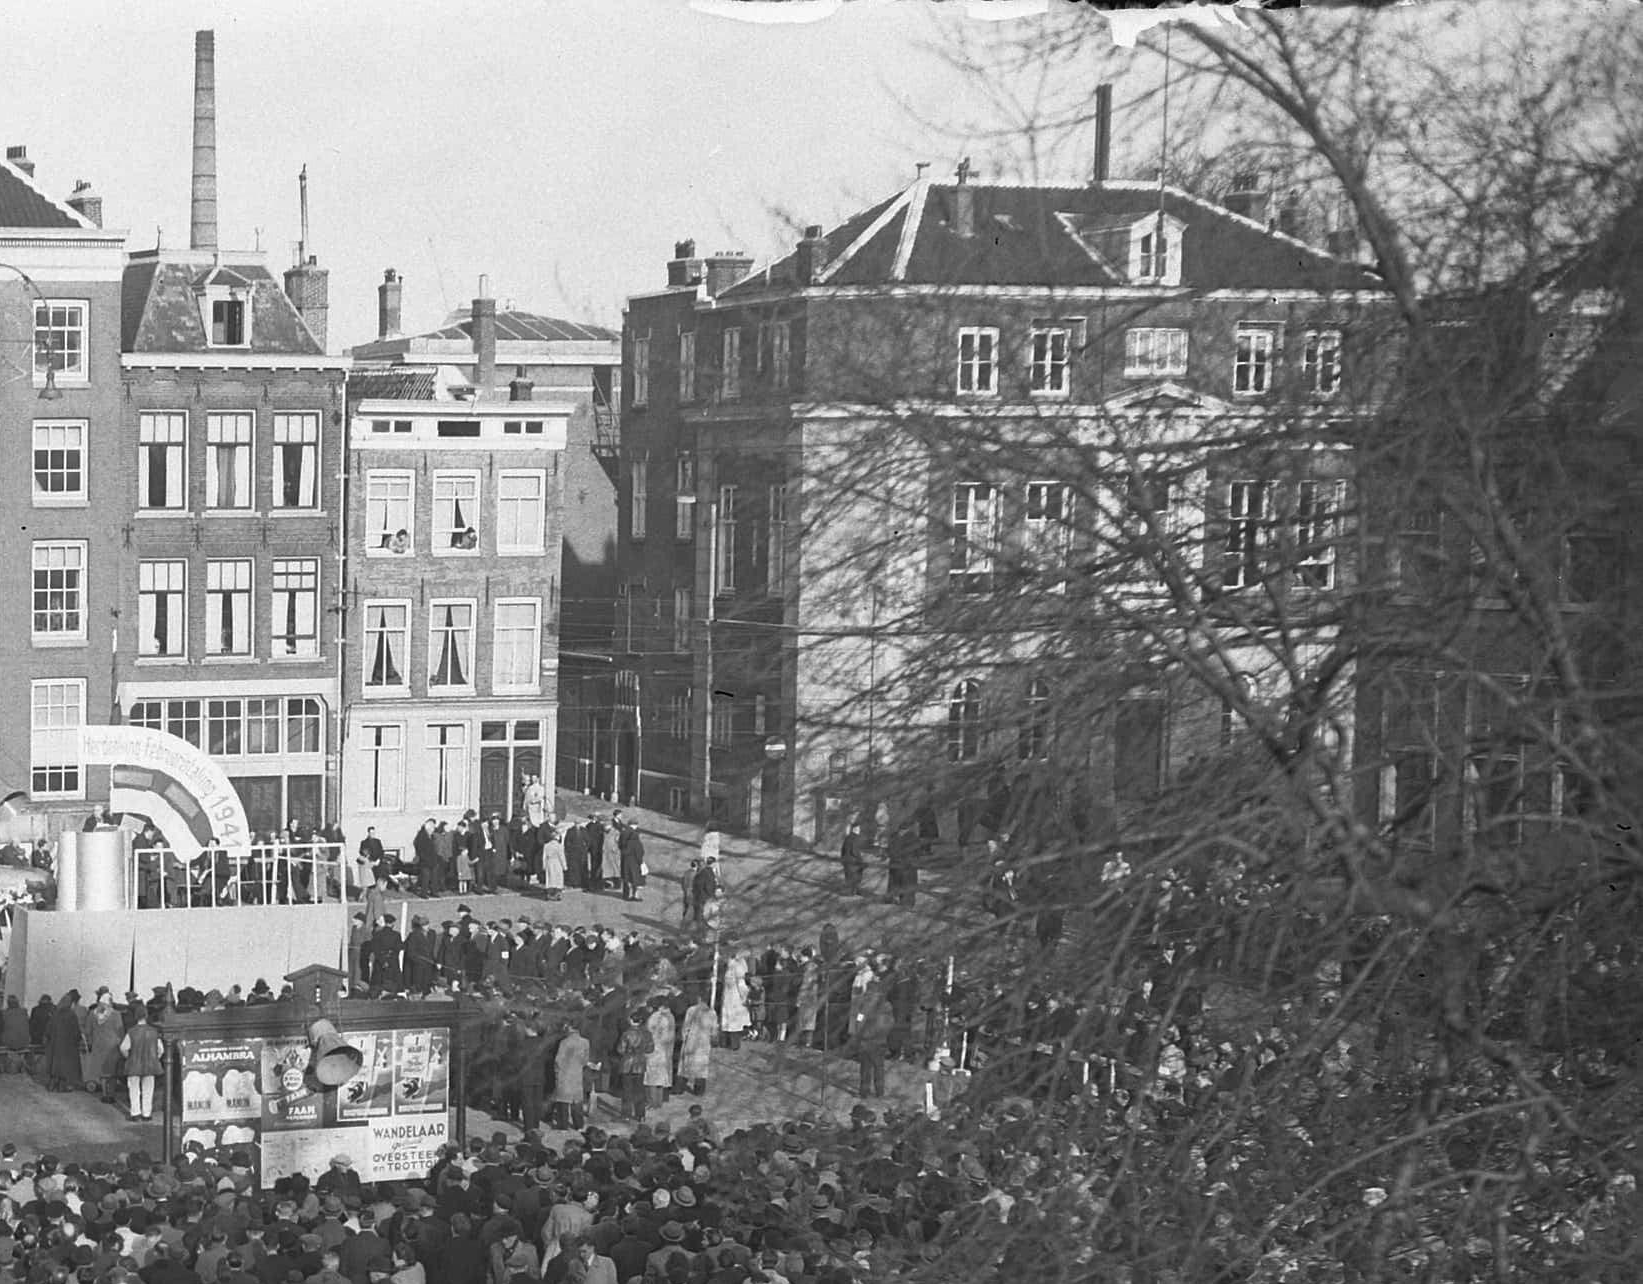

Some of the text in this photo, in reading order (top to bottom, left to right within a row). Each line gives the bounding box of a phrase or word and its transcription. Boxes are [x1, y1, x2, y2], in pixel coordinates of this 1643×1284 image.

[210, 795, 243, 848] 1941
[191, 1051, 255, 1063] ALHAMBRA
[372, 1122, 446, 1139] WANDELAAR
